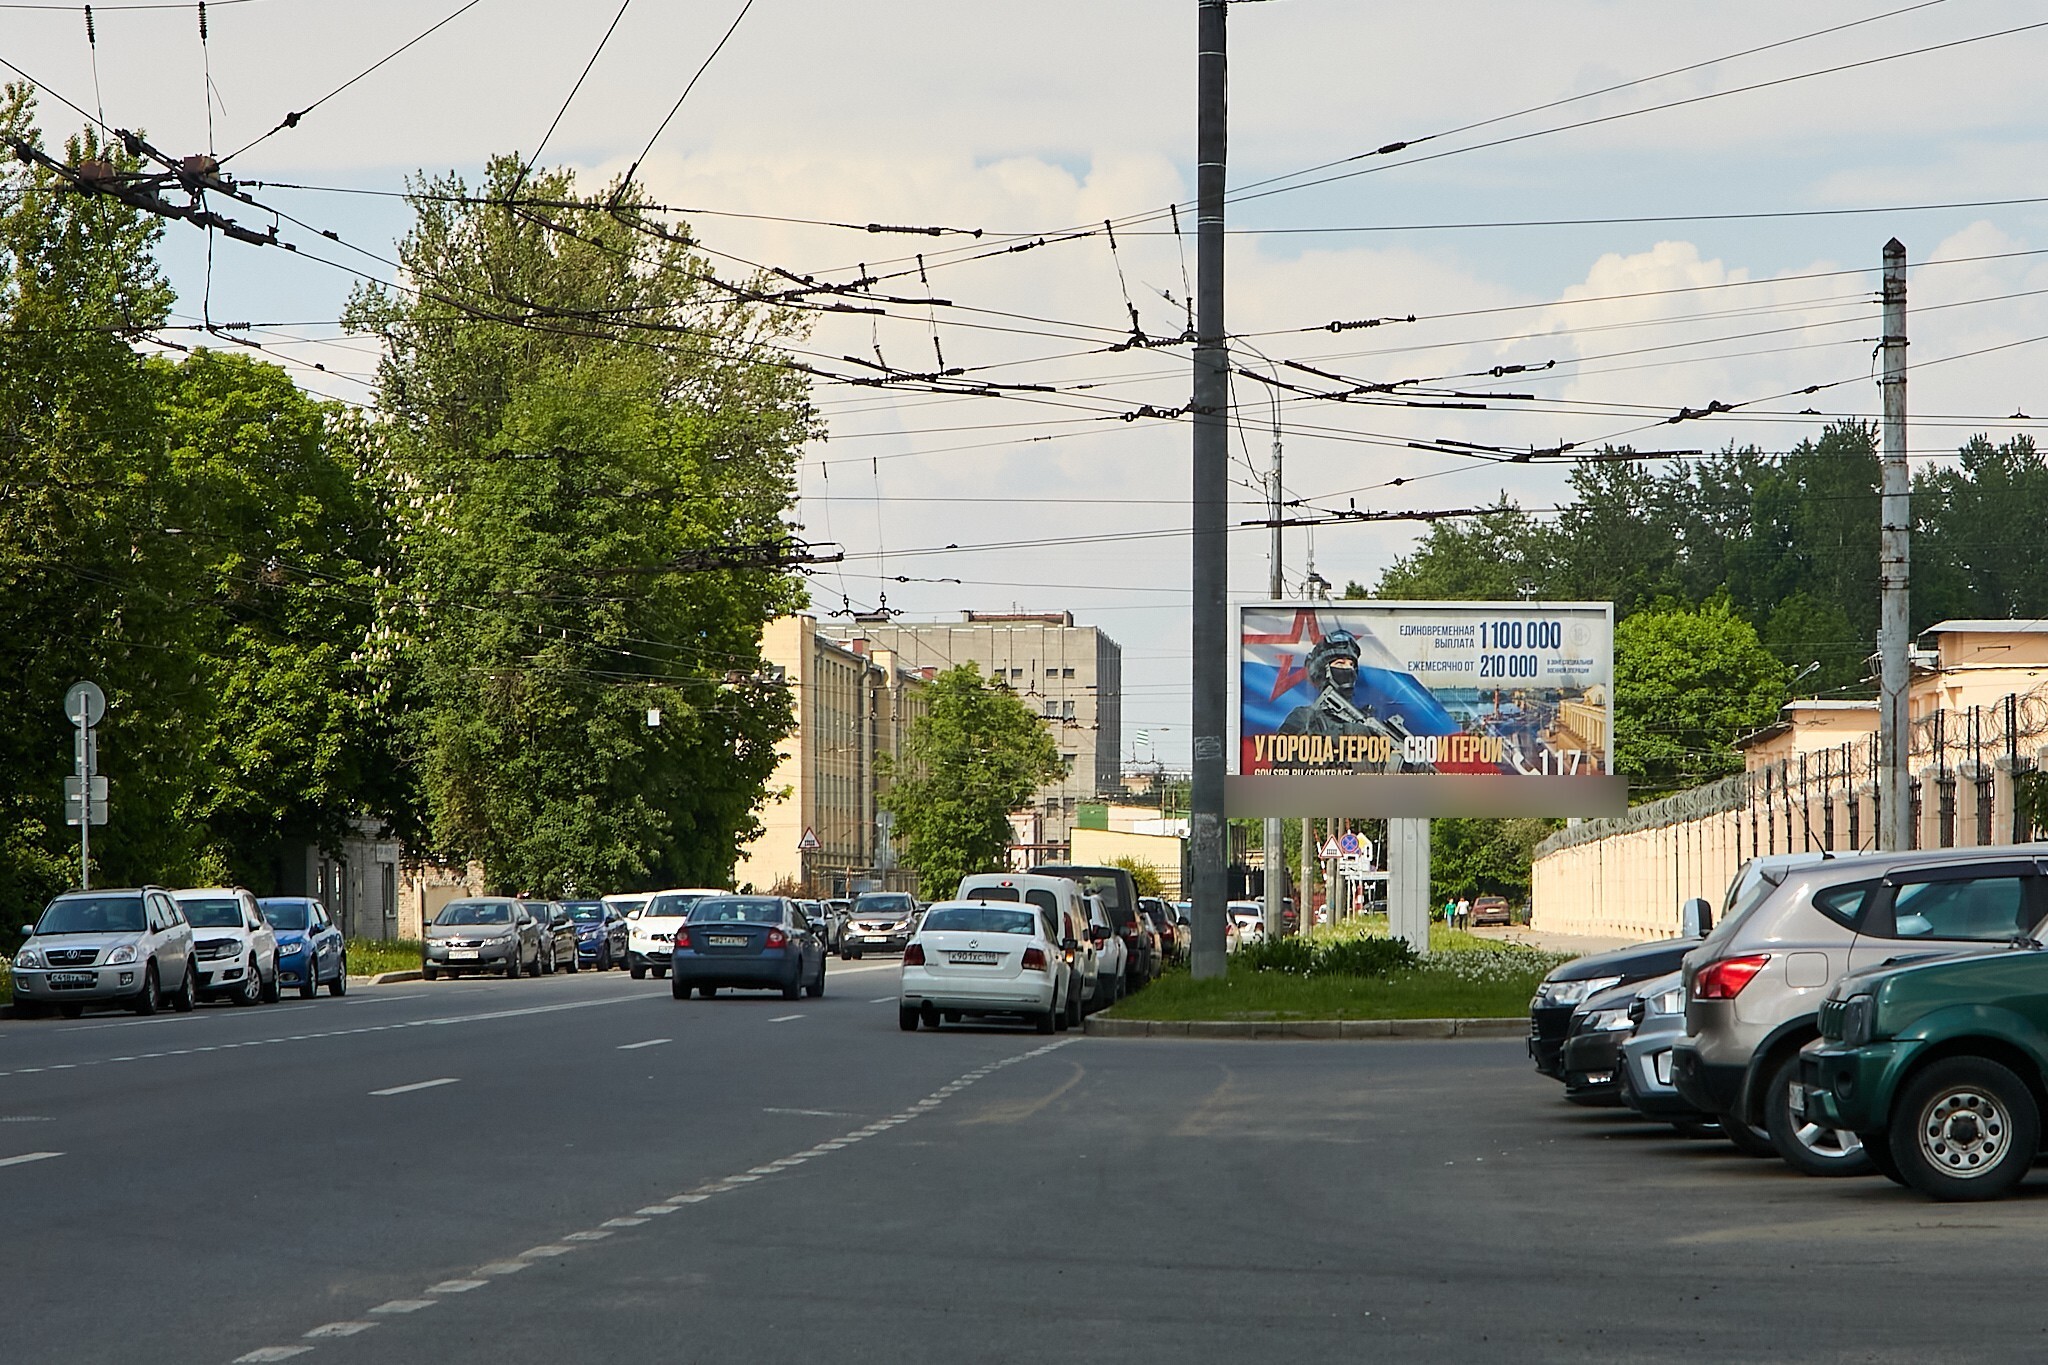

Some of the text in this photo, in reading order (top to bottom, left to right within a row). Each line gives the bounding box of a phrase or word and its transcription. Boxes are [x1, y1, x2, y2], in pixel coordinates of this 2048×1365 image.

[1400, 625, 1475, 636] ЕДИНОВРЕМЕННАЯ
[1479, 621, 1561, 649] 1 100 000
[1434, 638, 1475, 649] ВЫПЛАТА
[1408, 661, 1475, 672] ЕЖЕМЕСЯЧНО ОТ
[1480, 655, 1538, 678] 210 000
[1254, 735, 1266, 762] У
[1267, 735, 1391, 766] ГОРОДА-ГЕРОЯ
[1404, 735, 1449, 763] СВОИ
[1451, 735, 1503, 763] ГЕРОИ
